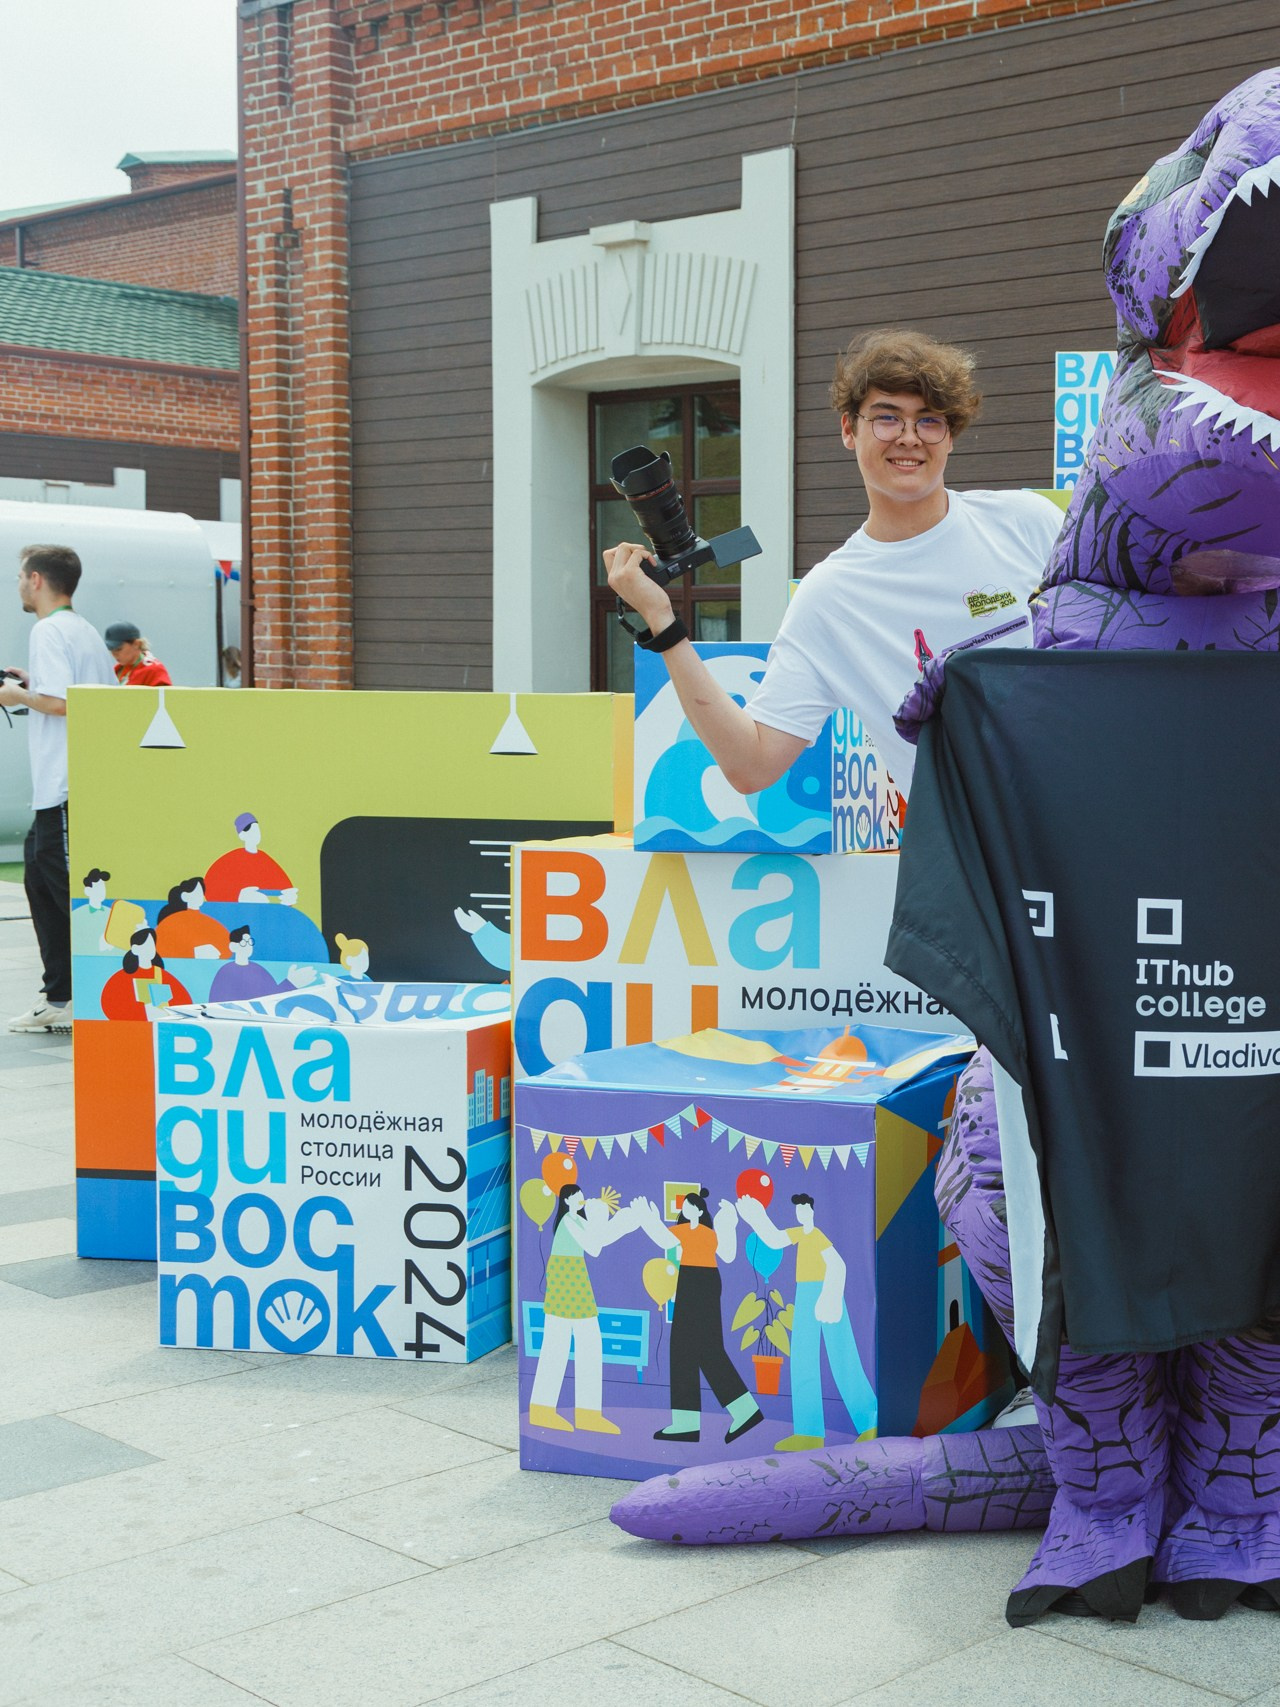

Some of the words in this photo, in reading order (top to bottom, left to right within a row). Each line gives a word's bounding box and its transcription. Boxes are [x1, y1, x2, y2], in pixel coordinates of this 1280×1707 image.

[1136, 958, 1234, 986] IThub
[741, 983, 951, 1016] молодёжна
[1135, 991, 1266, 1024] college
[300, 1110, 443, 1133] молодёжная
[300, 1138, 394, 1160] столица
[300, 1165, 381, 1187] России
[402, 1145, 467, 1359] 2024
